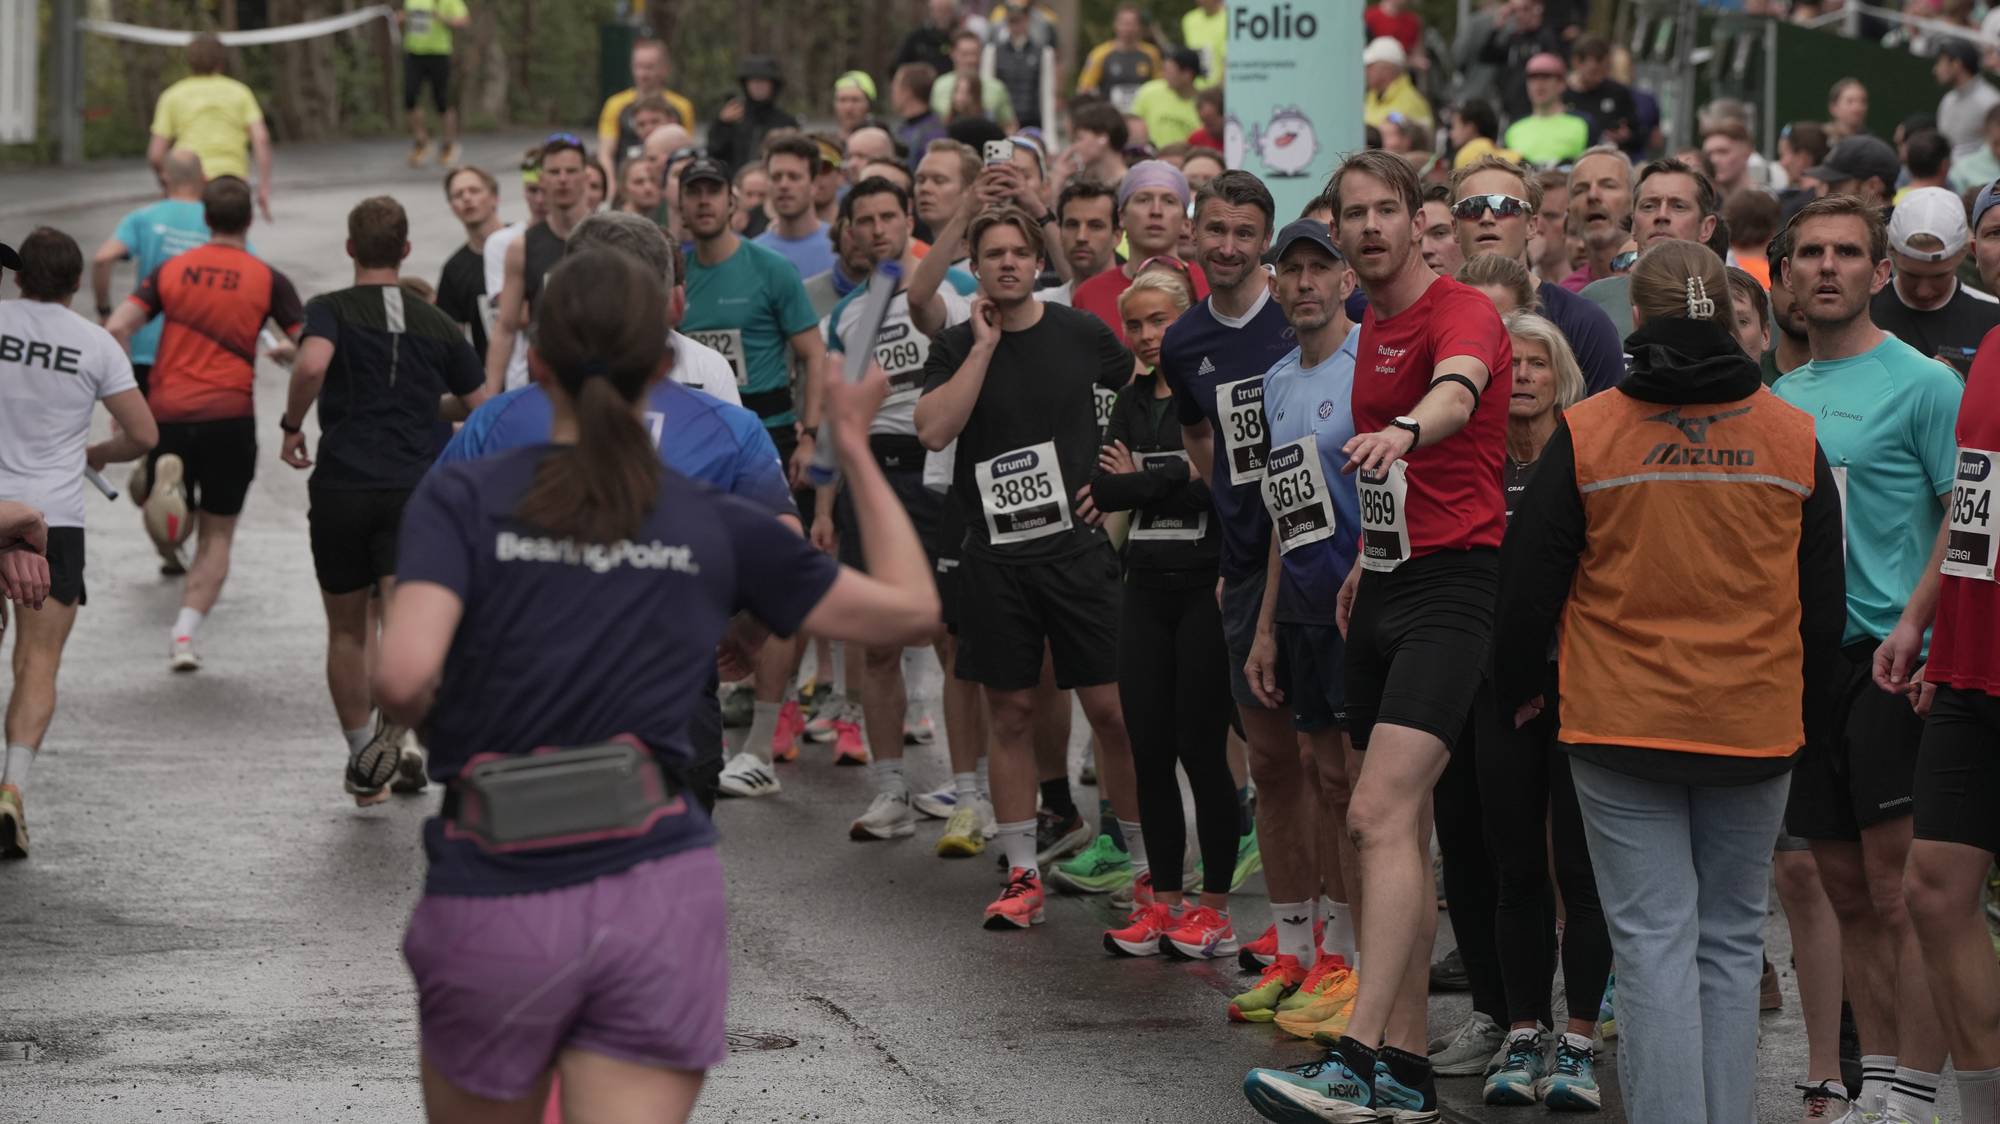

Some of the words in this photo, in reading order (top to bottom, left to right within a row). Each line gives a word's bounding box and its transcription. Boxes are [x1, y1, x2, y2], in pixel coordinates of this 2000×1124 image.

[1234, 4, 1317, 40] Folio
[182, 266, 241, 290] NTB
[0, 334, 82, 374] BRE
[1237, 387, 1263, 401] trum
[1230, 408, 1263, 442] 38
[996, 453, 1033, 473] trumf
[1269, 448, 1300, 471] trumf
[1960, 460, 1985, 476] rumf
[991, 471, 1053, 509] 3885
[1268, 469, 1315, 512] 3613
[1952, 485, 1991, 528] 854
[1288, 519, 1315, 538] ENERGI
[1327, 1082, 1360, 1099] HOKA
